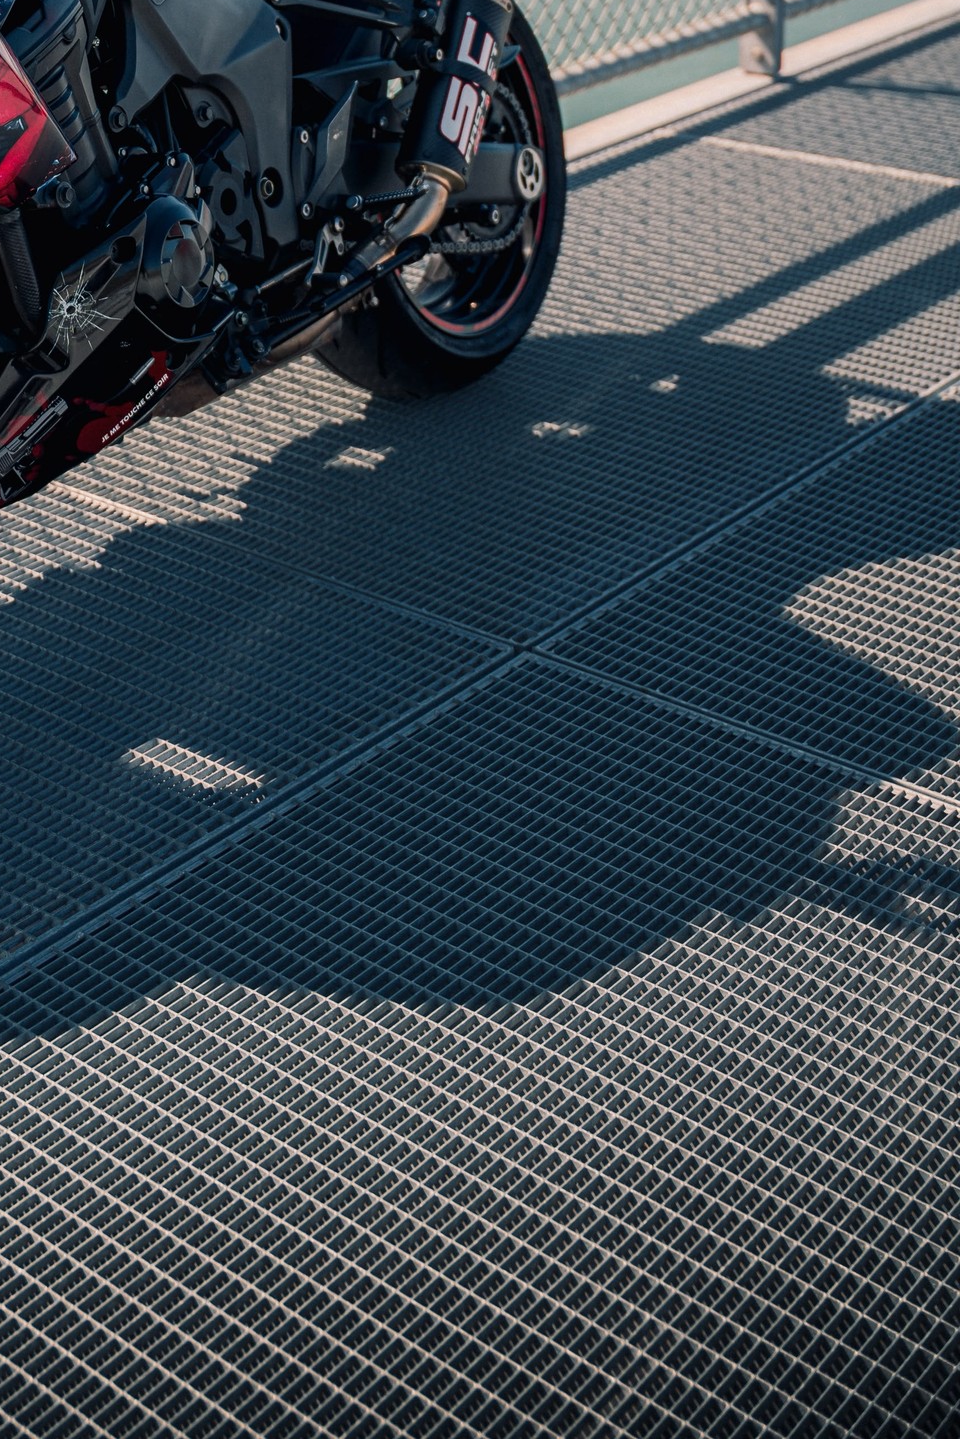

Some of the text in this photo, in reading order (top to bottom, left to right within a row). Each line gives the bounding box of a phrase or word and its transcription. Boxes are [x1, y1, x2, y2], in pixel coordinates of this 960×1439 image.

[465, 41, 498, 164] PROJCT
[101, 373, 169, 443] JE ME TOUCHE CE SOIR
